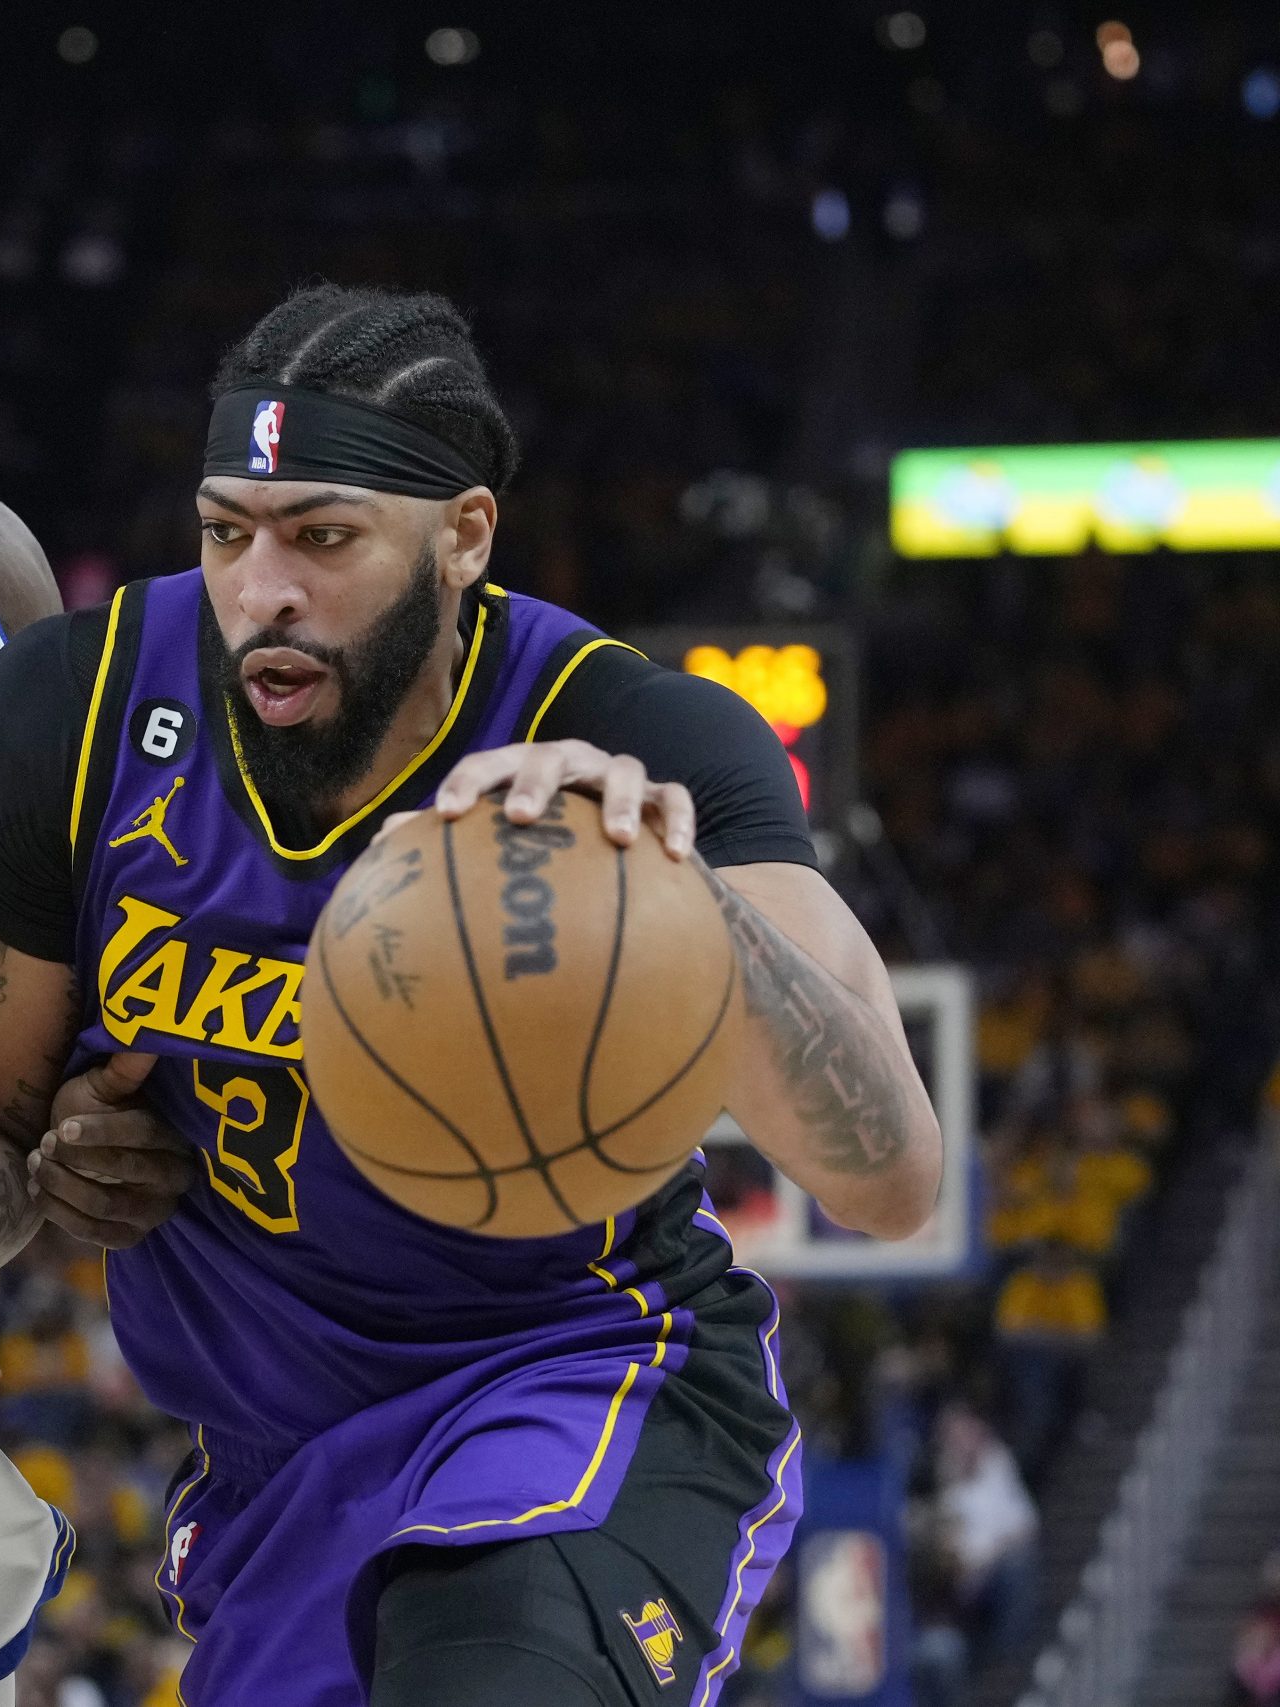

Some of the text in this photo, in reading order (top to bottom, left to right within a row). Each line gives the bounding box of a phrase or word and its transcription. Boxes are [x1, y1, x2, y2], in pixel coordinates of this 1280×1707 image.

[251, 456, 267, 470] NBA
[141, 706, 184, 759] 6
[98, 895, 306, 1061] LAKE
[193, 1058, 311, 1235] 3
